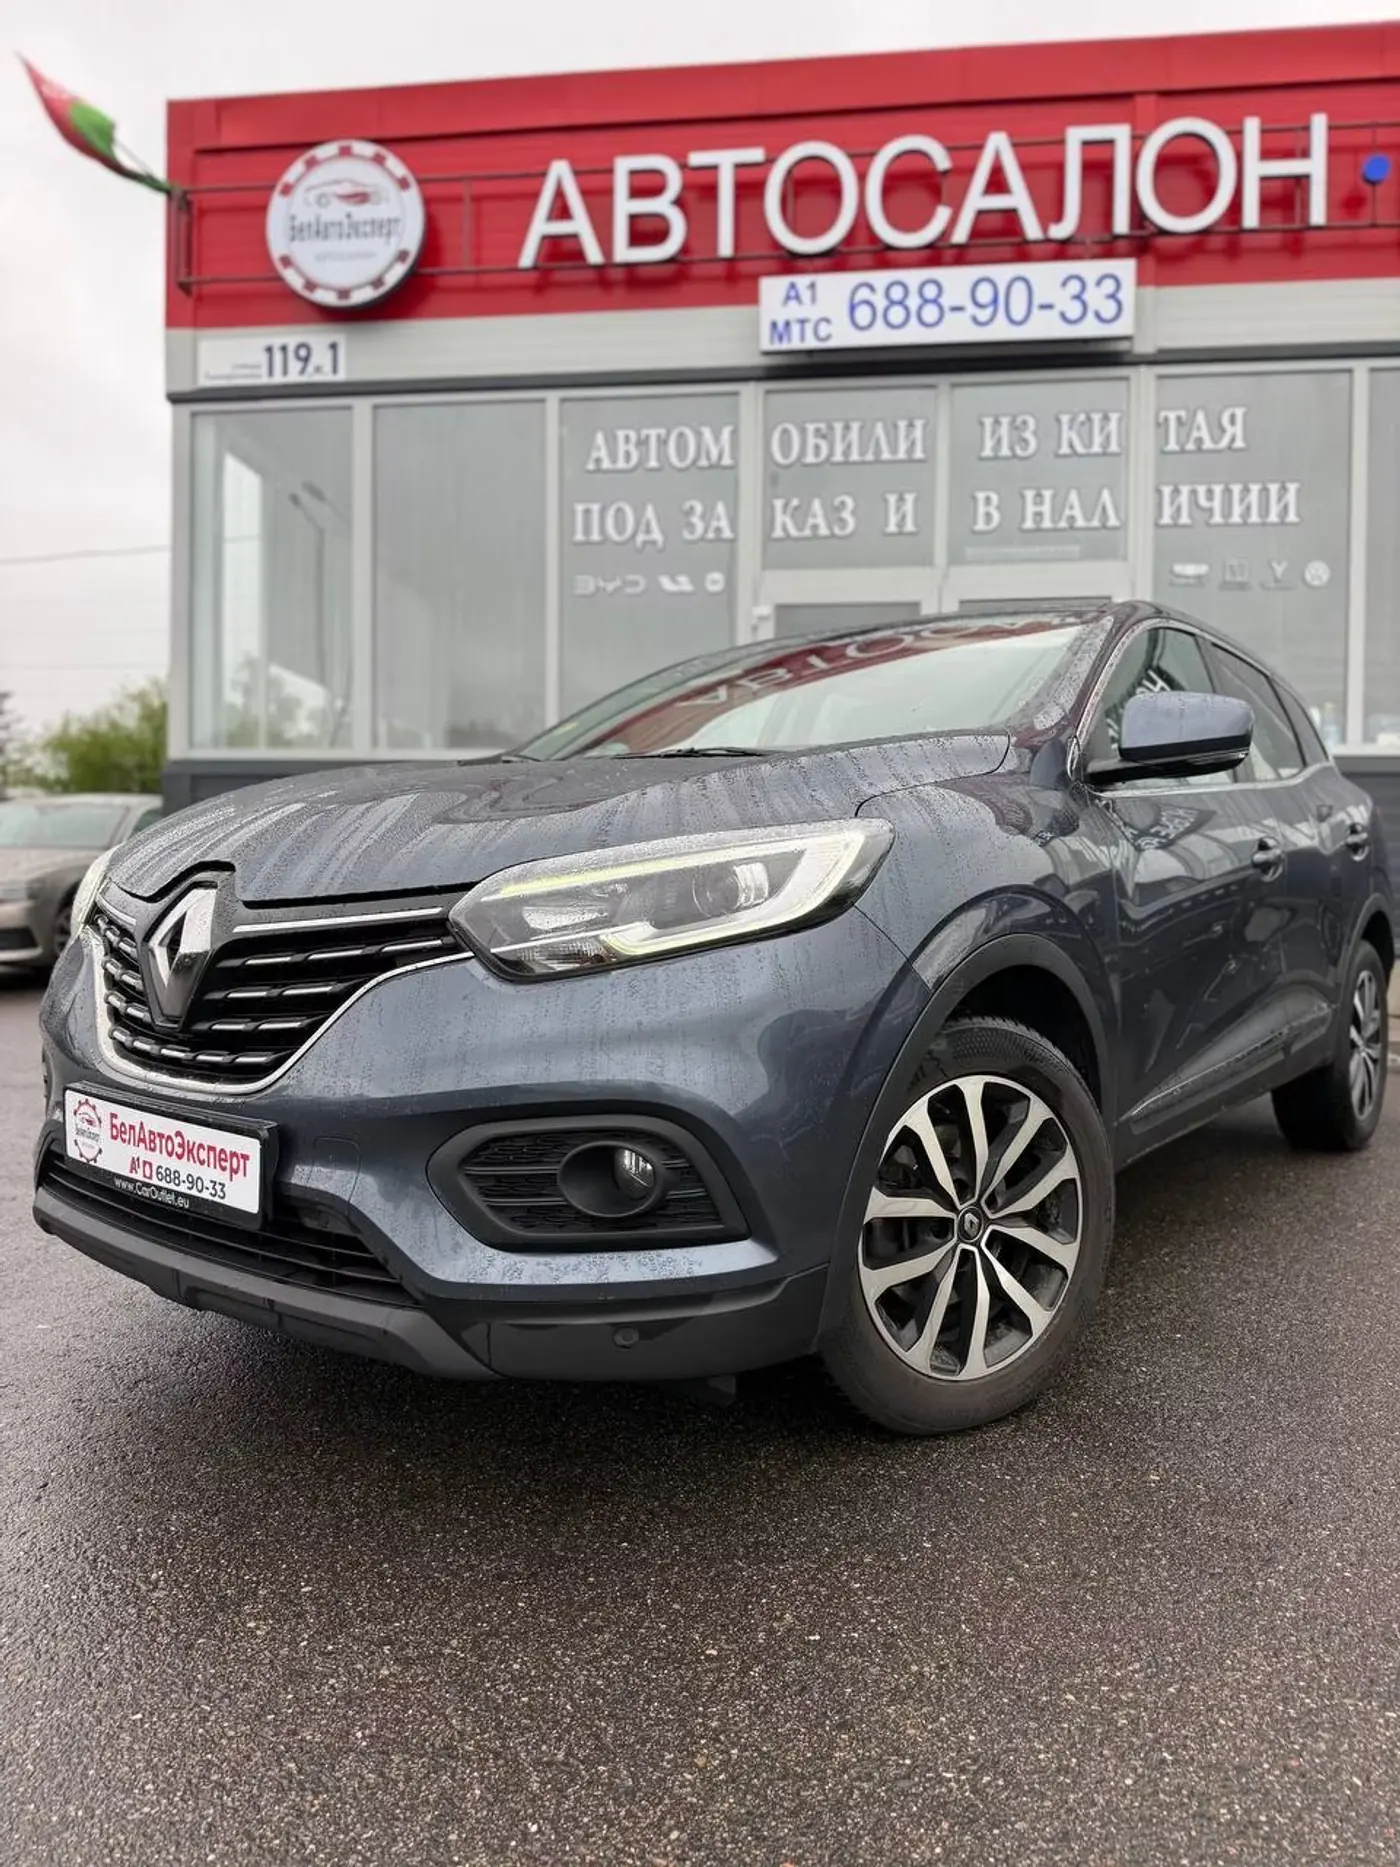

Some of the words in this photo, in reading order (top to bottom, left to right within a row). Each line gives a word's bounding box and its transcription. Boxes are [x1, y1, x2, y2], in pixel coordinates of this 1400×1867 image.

[518, 112, 1328, 268] АВТОСАЛОН
[848, 273, 1124, 331] 688-90-33
[769, 317, 832, 345] МТС
[264, 342, 312, 378] 119
[978, 414, 1038, 459] ИЗ
[573, 502, 664, 549] ПОД
[884, 493, 918, 535] И
[972, 491, 1001, 532] В
[109, 1112, 250, 1181] БелАвтоЭксперт
[114, 1177, 190, 1208] www.CarOutlet.eu
[155, 1165, 226, 1199] 688-90-33
